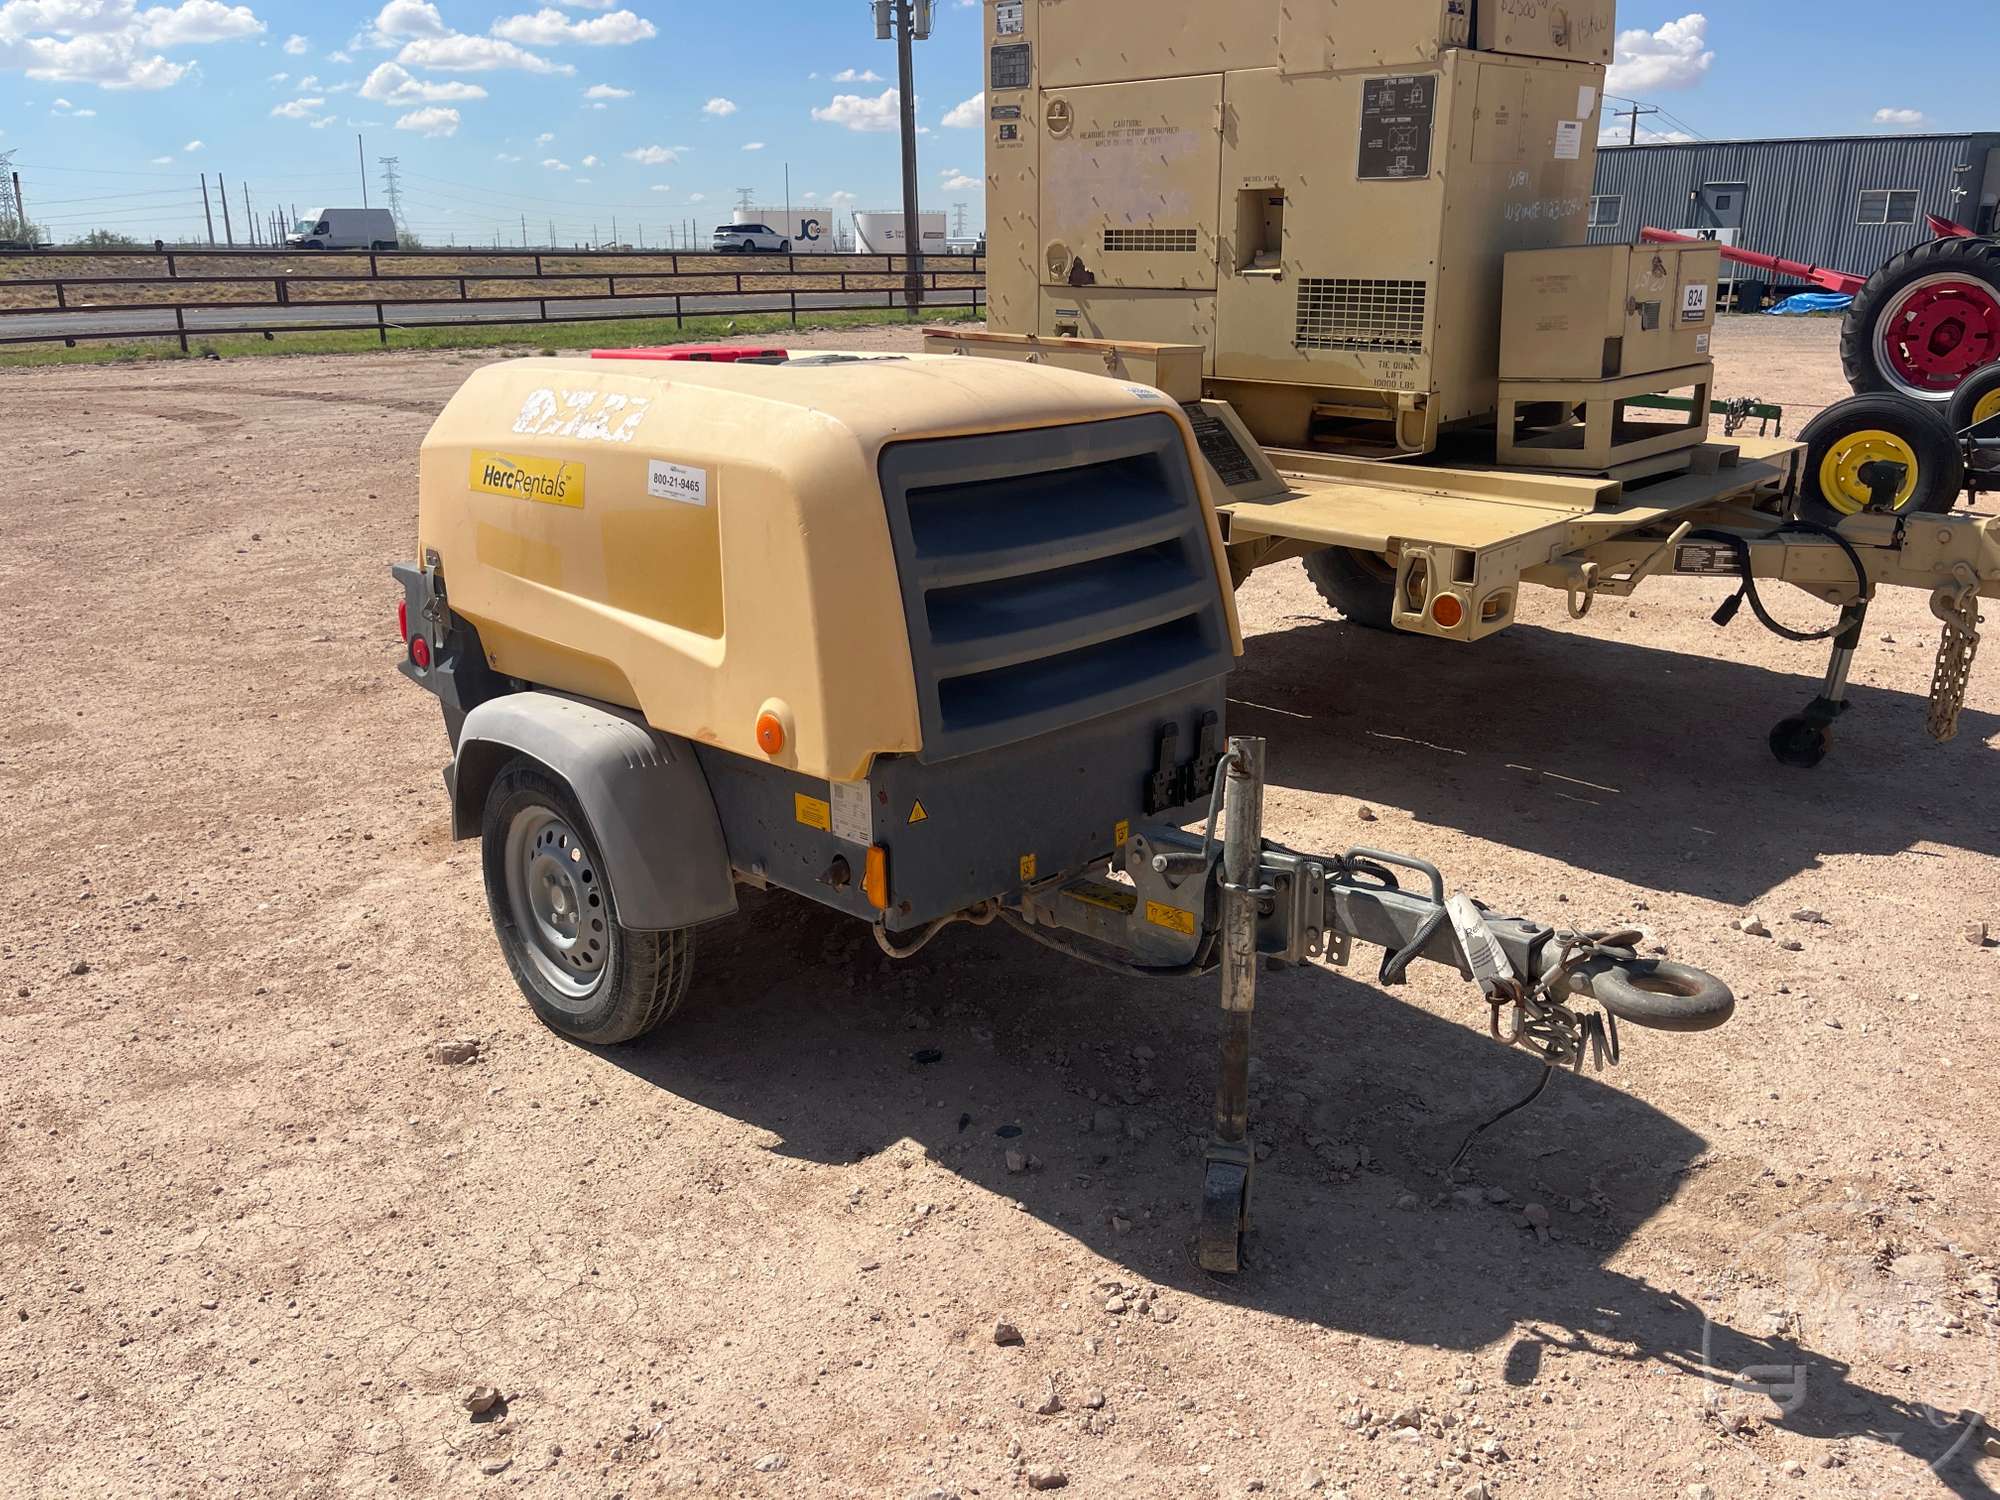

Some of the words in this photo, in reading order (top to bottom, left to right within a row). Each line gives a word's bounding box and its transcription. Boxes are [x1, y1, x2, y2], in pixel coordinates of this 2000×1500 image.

[1687, 289, 1703, 306] 824
[1378, 360, 1390, 369] TIE
[1393, 361, 1414, 370] DOWN
[1385, 371, 1403, 379] LIFT
[1400, 380, 1415, 389] LBS
[653, 472, 700, 492] 800-21-9465
